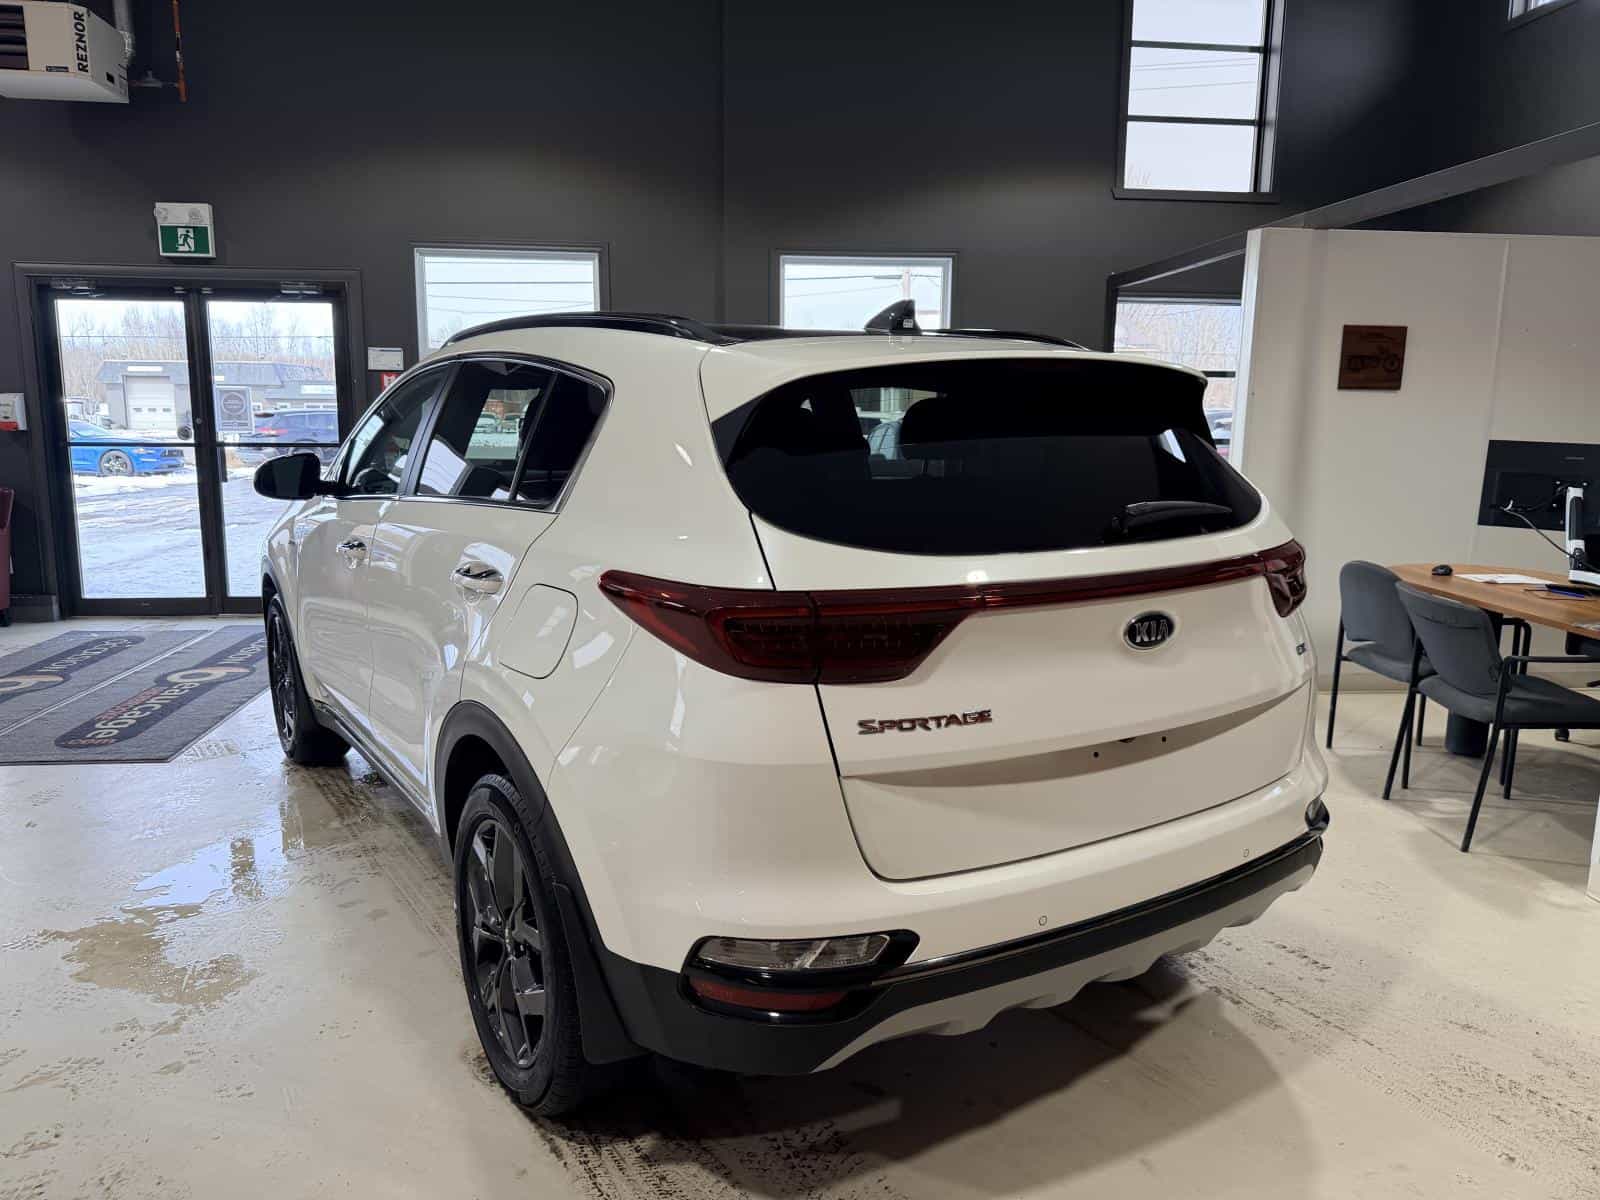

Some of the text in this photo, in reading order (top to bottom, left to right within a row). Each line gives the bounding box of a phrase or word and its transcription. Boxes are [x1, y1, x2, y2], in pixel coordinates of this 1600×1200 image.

[73, 11, 88, 73] REZNOR
[1134, 618, 1169, 643] KIA
[857, 709, 992, 735] SPORTAGE
